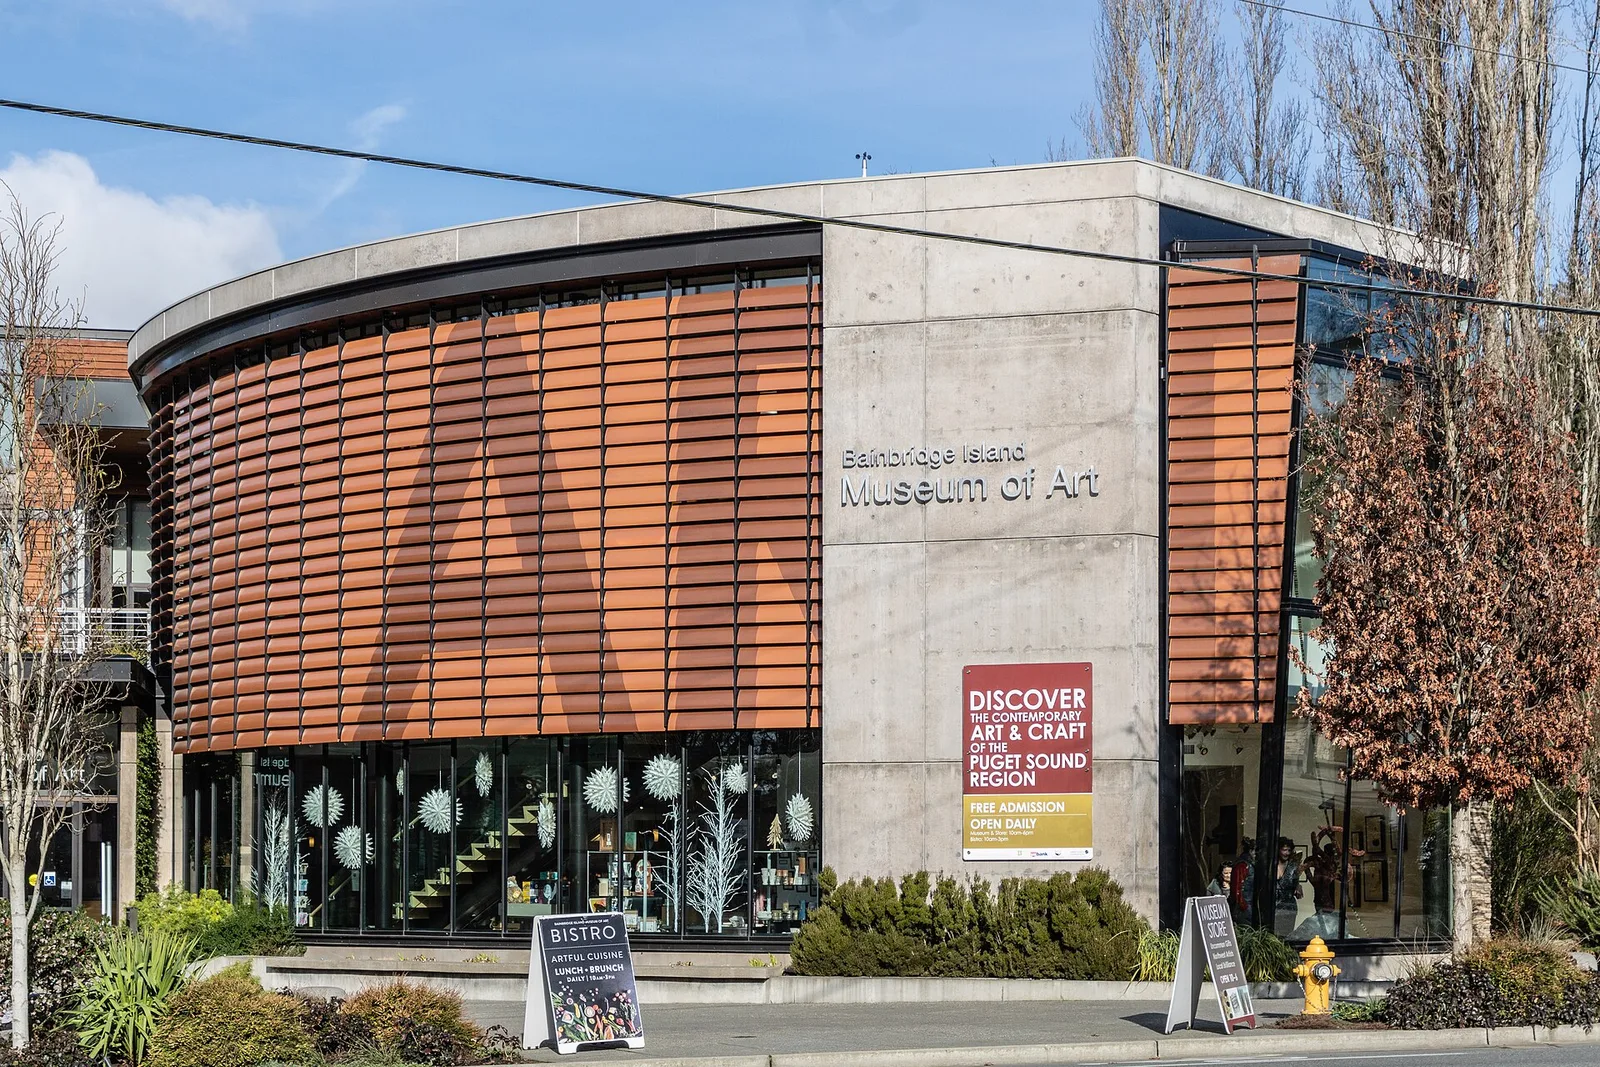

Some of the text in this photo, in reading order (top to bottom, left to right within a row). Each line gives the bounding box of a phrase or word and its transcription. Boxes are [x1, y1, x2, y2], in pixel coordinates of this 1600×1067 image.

[842, 442, 1025, 469] Bainbridge Island
[841, 465, 1099, 507] Museum of Art
[969, 688, 1086, 711] DISCOVER
[970, 711, 1082, 723] THE CONTEMPORARY
[970, 722, 1086, 741] ART & CRAFT
[970, 742, 1008, 753] OF THE
[970, 753, 1087, 770] PUGET SOUND
[970, 771, 1036, 787] REGION
[970, 801, 1065, 813] FREE ADMISSION
[970, 818, 1037, 830] OPEN DAILY
[1200, 904, 1228, 920] MUSEUM
[550, 927, 615, 942] BISTRO
[1207, 921, 1228, 938] STORE
[551, 951, 624, 963] ARTFUL CUISINE
[554, 964, 624, 975] LUNCH BRUNCH
[566, 975, 585, 983] DAILY
